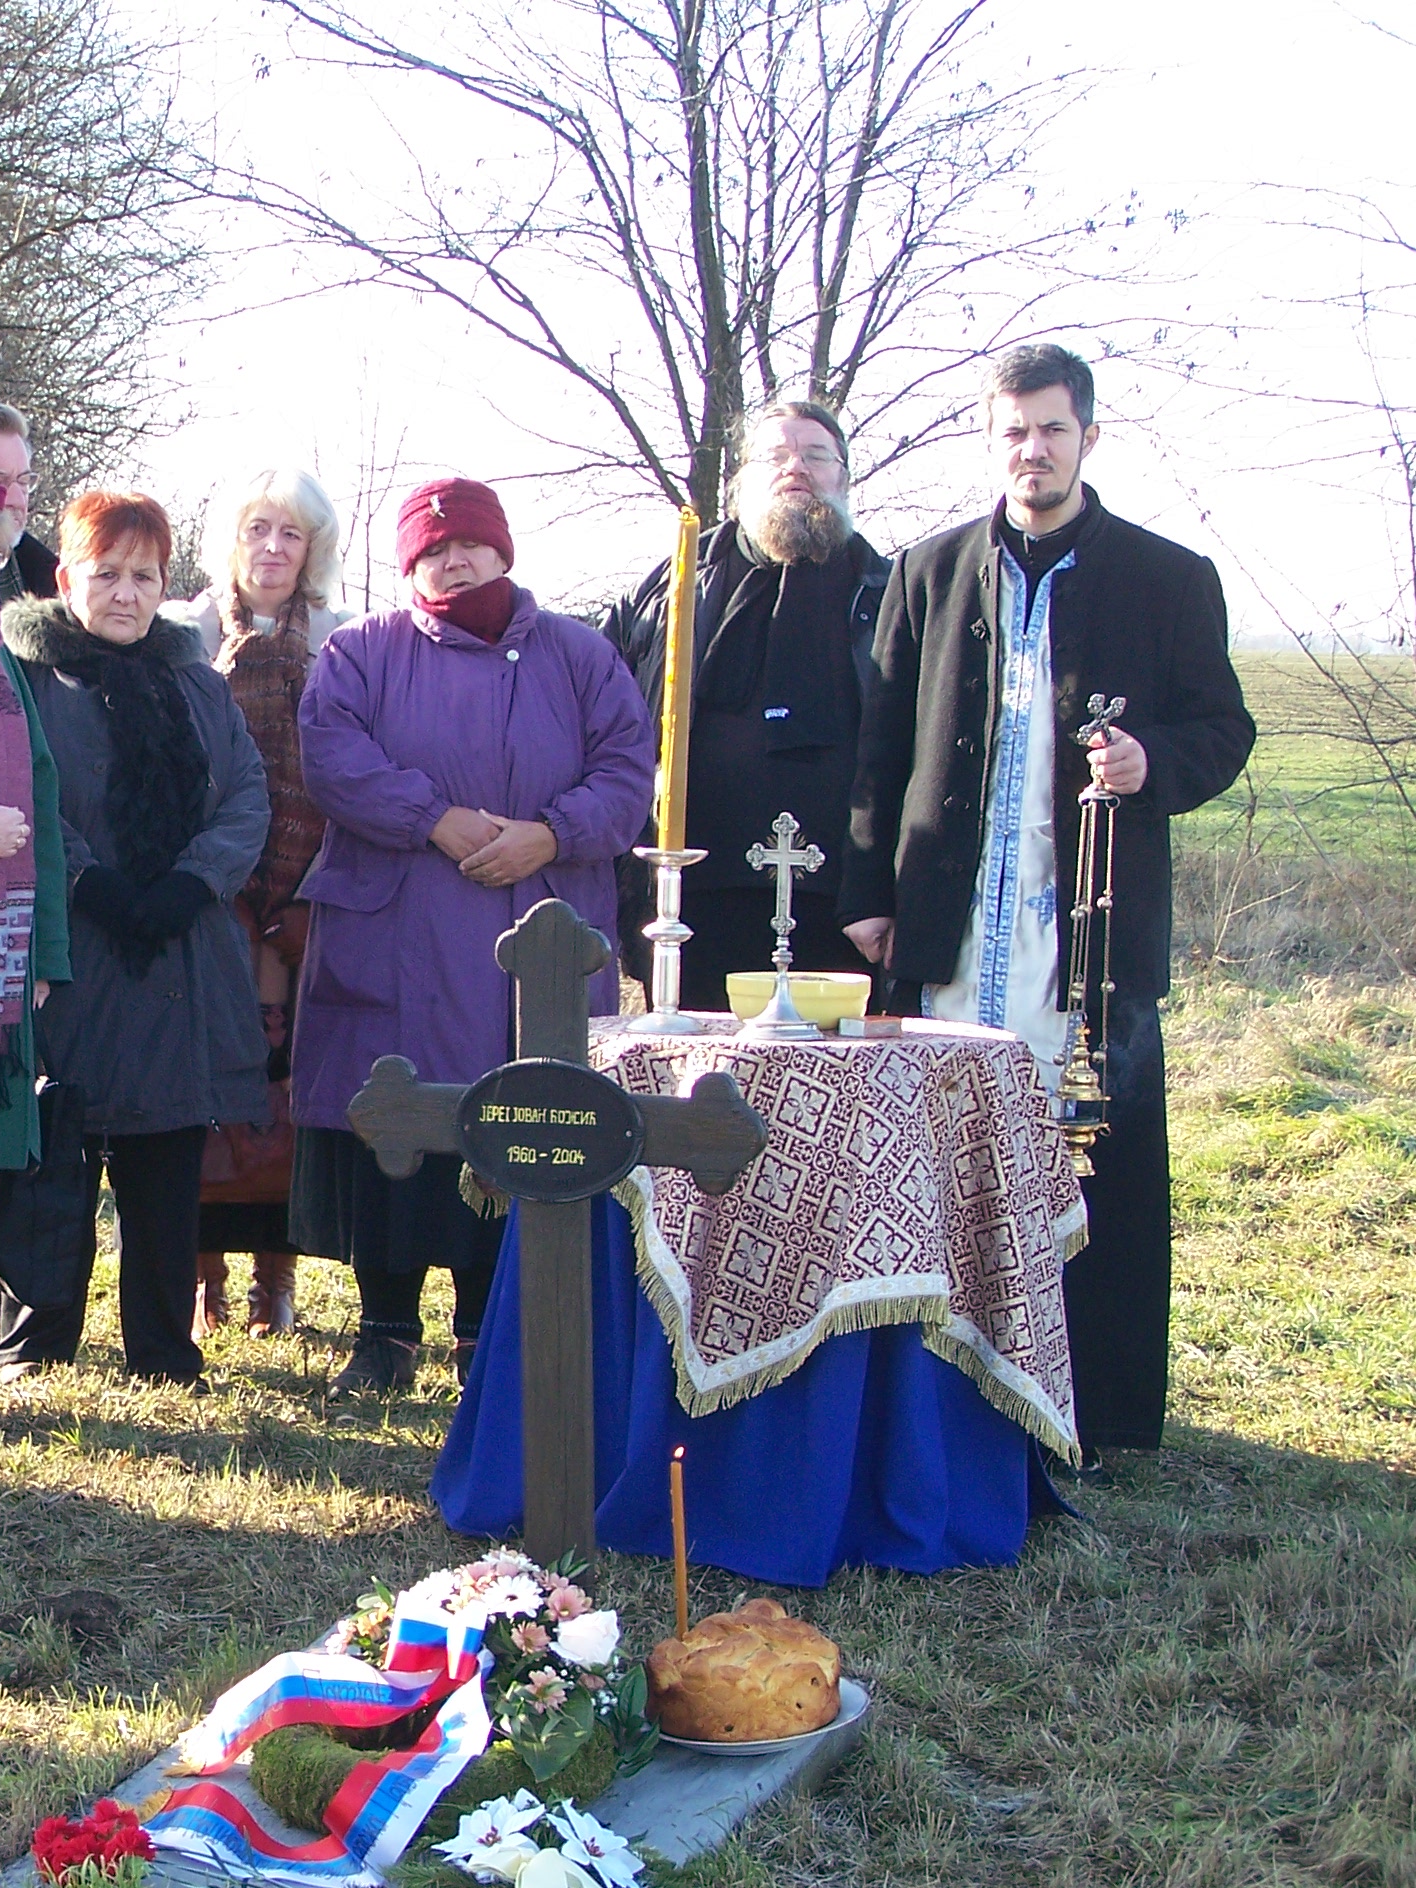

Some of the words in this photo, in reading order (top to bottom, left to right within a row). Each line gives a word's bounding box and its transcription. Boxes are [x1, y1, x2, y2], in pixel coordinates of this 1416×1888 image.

[512, 1107, 547, 1124] ЈОВАН
[506, 1145, 537, 1164] 1960
[551, 1147, 586, 1165] 2004
